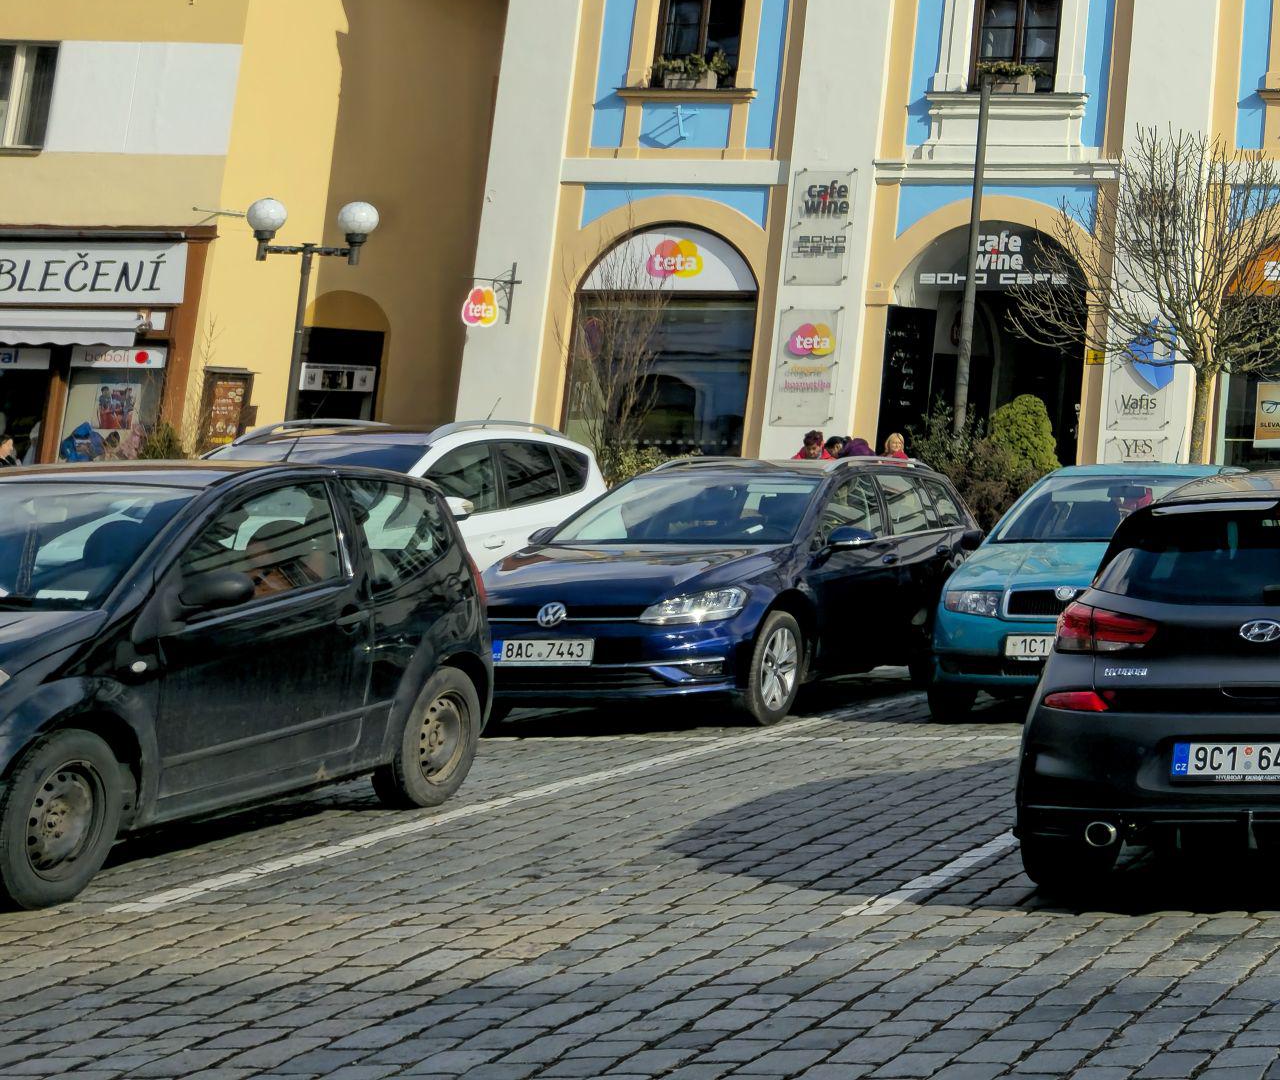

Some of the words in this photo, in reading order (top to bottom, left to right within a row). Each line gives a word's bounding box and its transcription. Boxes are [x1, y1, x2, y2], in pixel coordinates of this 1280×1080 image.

[808, 180, 848, 199] cafe
[804, 200, 849, 214] wine
[977, 230, 1022, 252] cafe
[655, 254, 698, 271] teta
[976, 254, 1023, 270] wine
[469, 302, 493, 318] teta
[796, 334, 830, 349] teta
[1121, 394, 1157, 410] Vafis
[505, 643, 534, 658] 8AC
[546, 643, 585, 658] 7443
[1020, 638, 1047, 653] 1C1
[1194, 746, 1238, 771] 9C1
